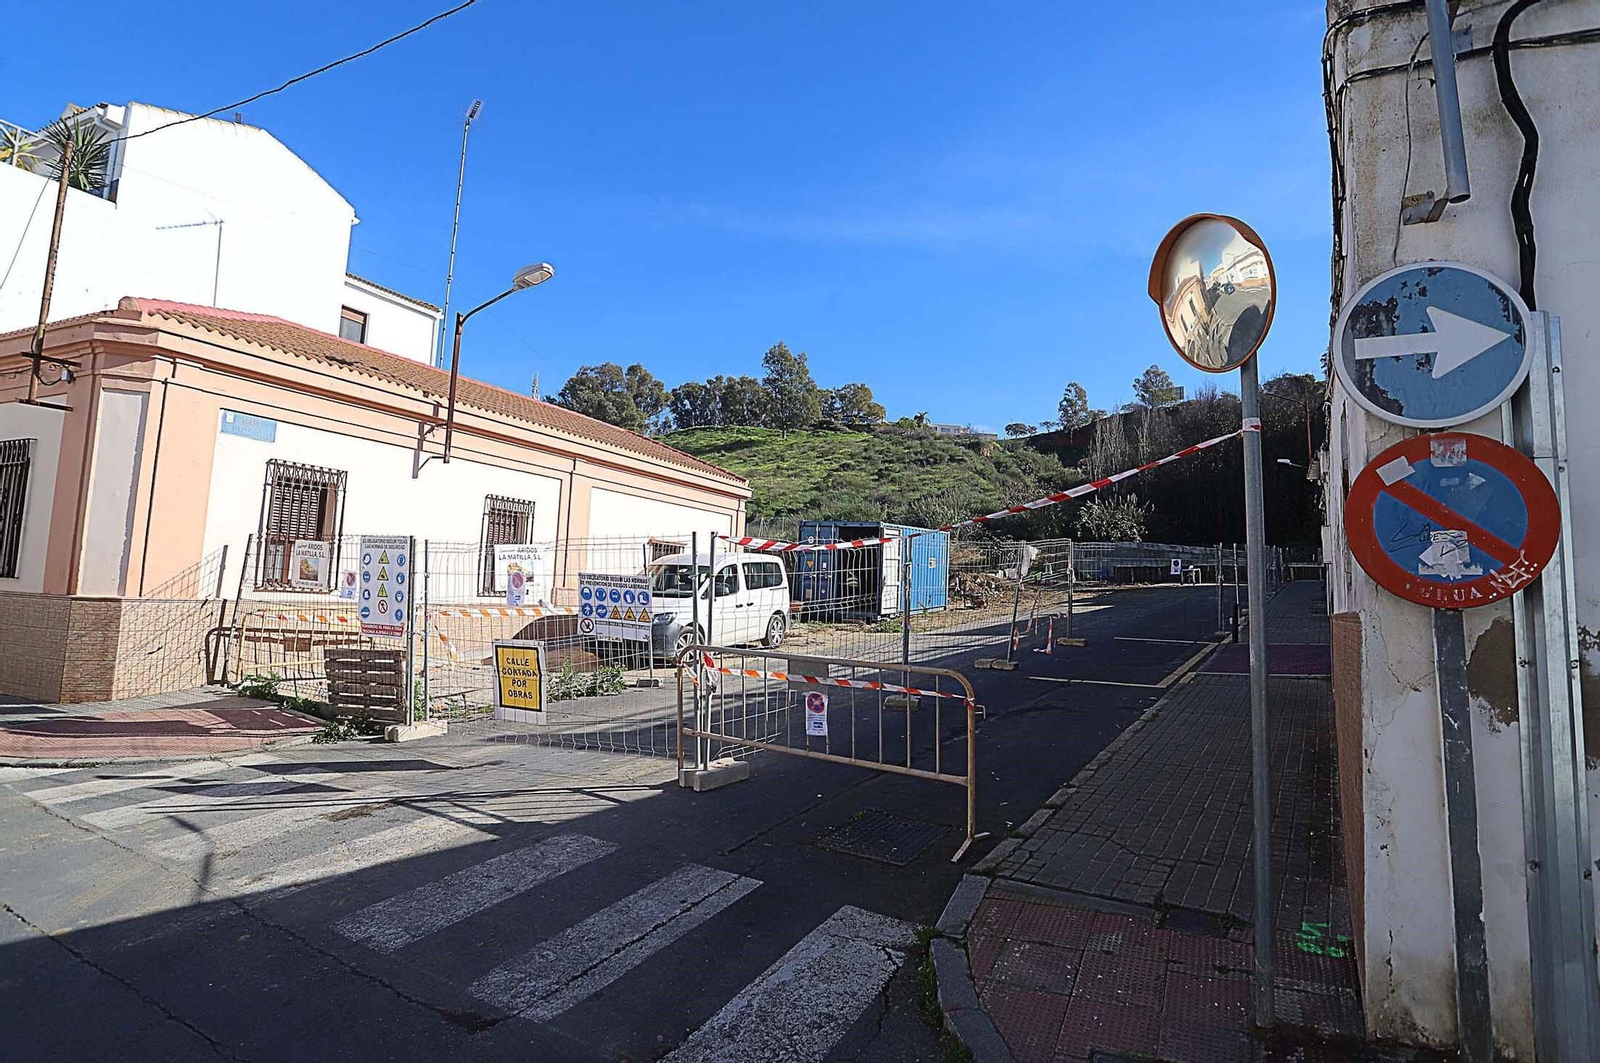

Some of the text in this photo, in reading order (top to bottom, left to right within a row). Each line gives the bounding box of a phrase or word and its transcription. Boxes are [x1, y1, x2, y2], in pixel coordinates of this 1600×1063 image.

[506, 657, 529, 666] CALLE
[502, 668, 538, 678] CORTADA
[512, 679, 527, 688] POR
[508, 690, 533, 700] OBRAS
